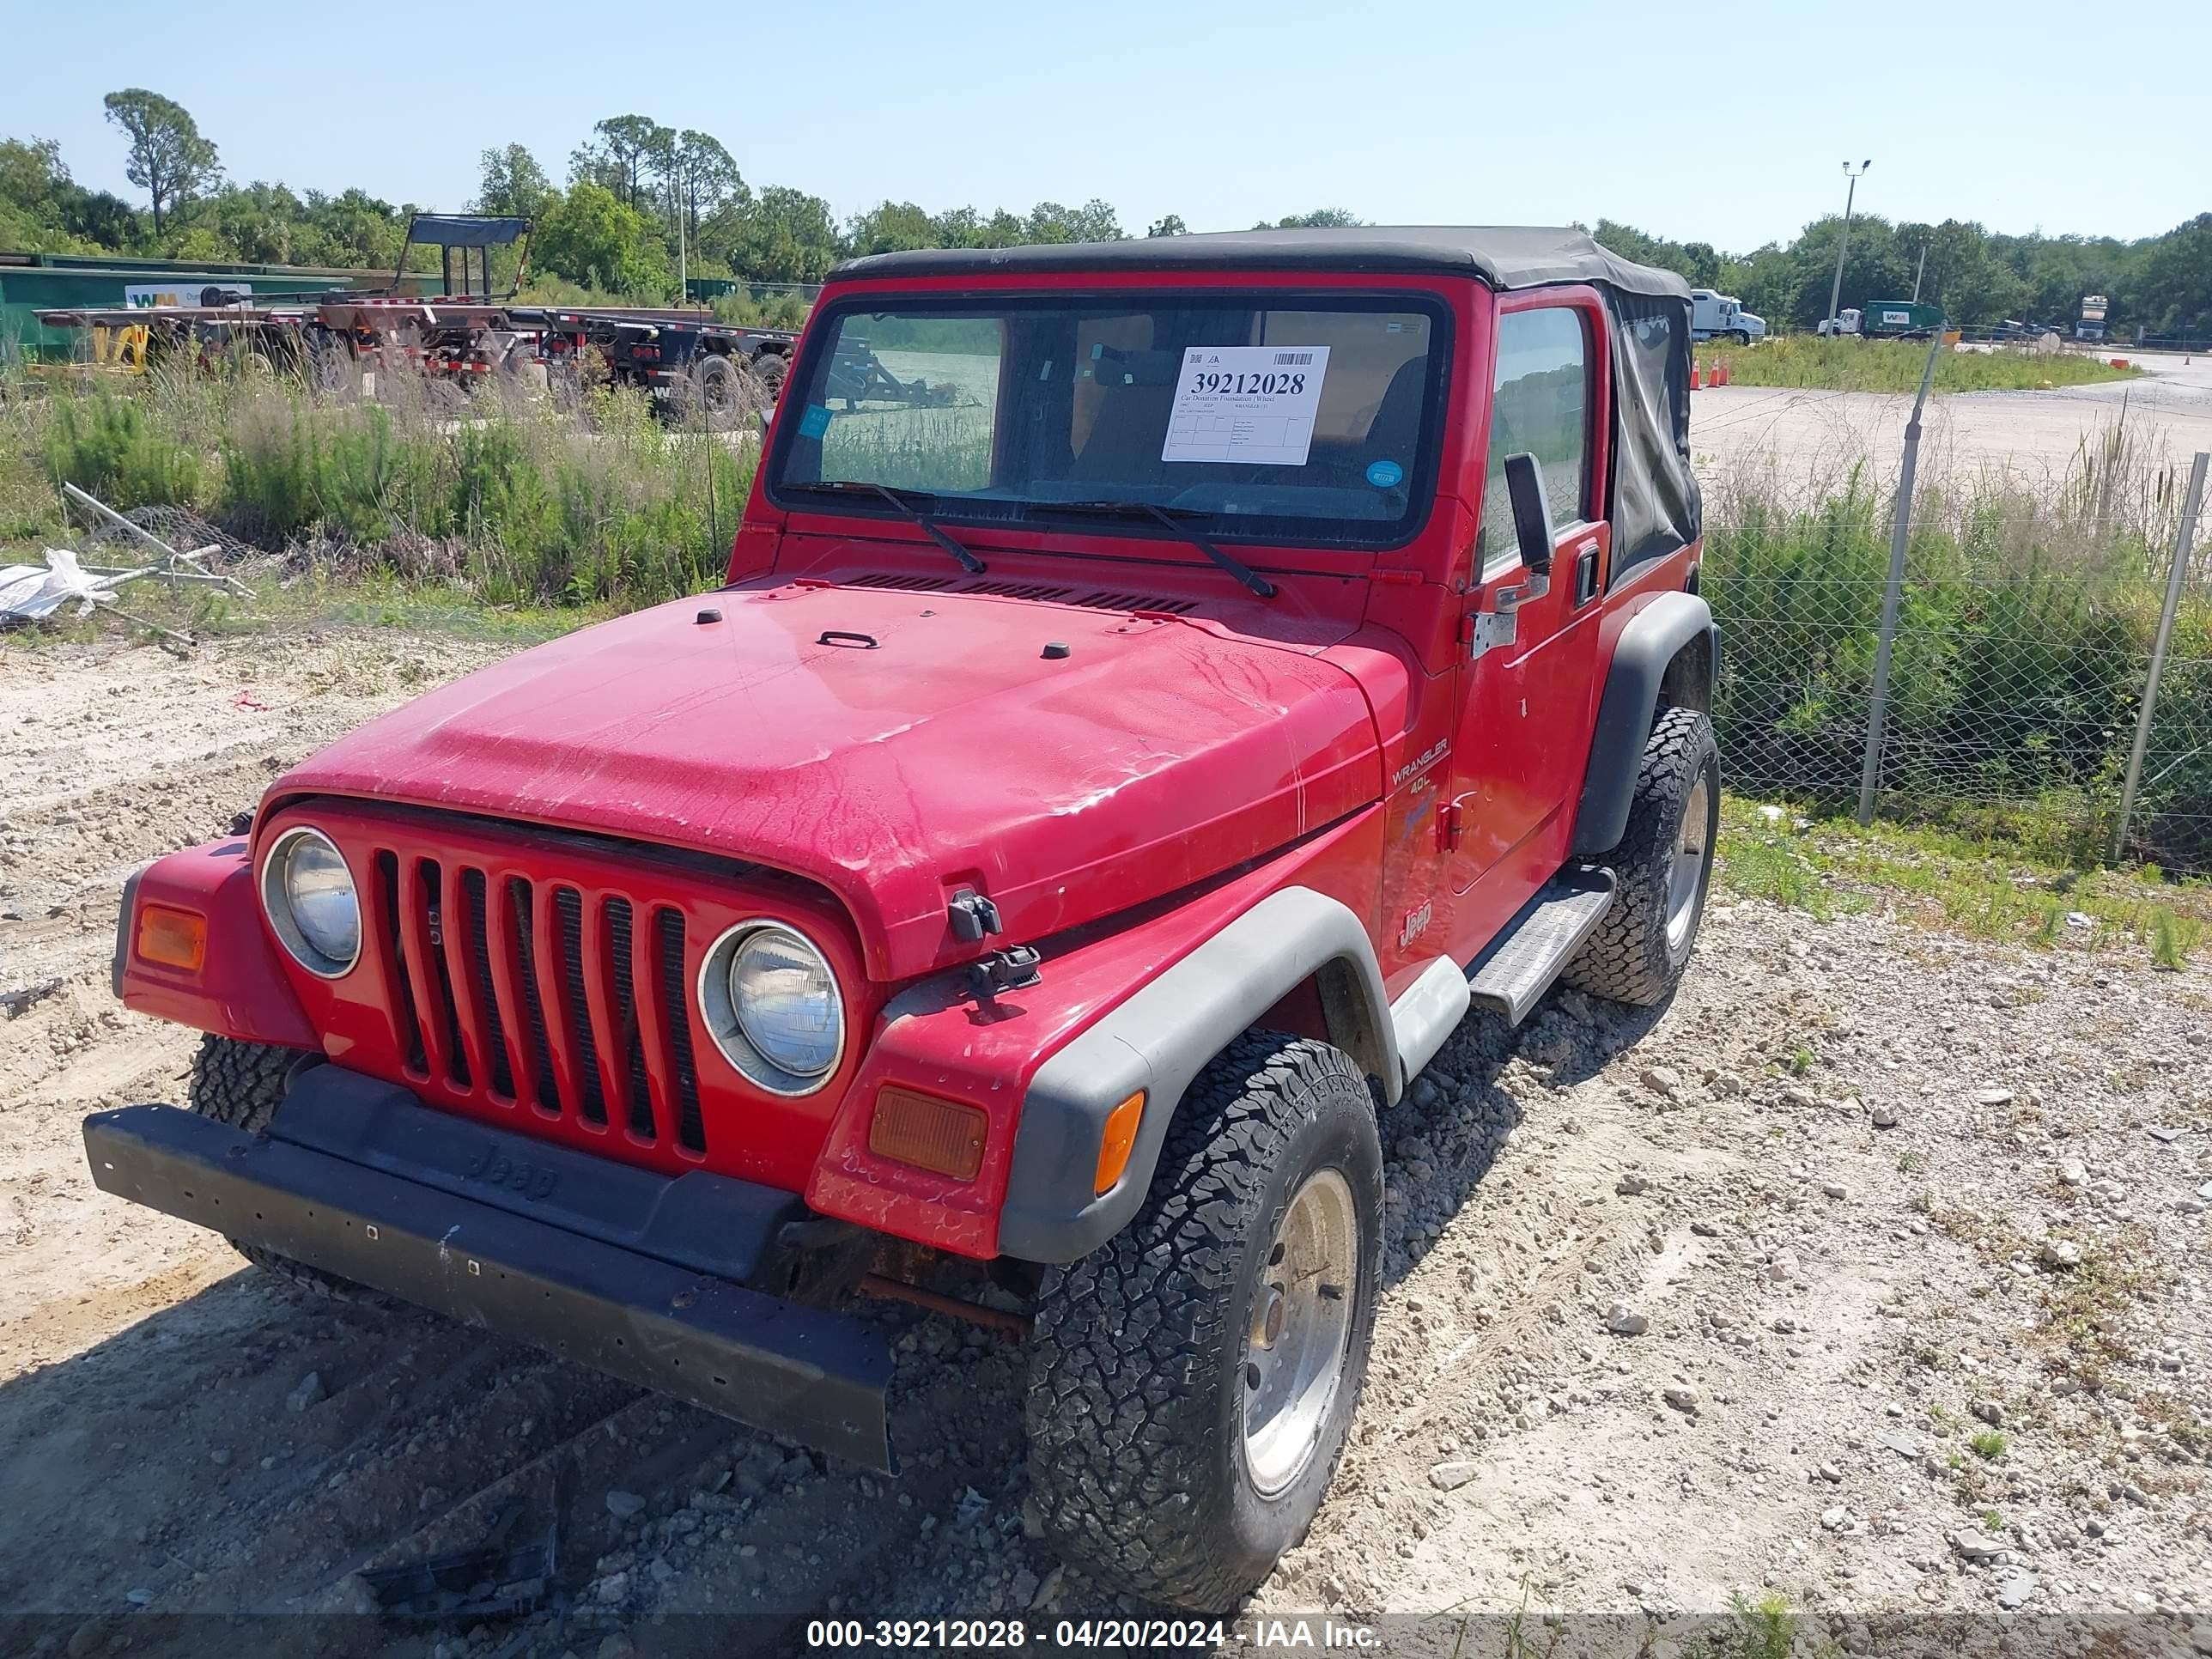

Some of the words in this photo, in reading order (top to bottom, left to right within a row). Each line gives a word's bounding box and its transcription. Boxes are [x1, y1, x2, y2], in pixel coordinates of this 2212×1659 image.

[1191, 373, 1306, 395] 39212028
[1392, 738, 1448, 786] WRANGLER
[1397, 899, 1432, 950] Jeep
[466, 1140, 560, 1202] Jeep
